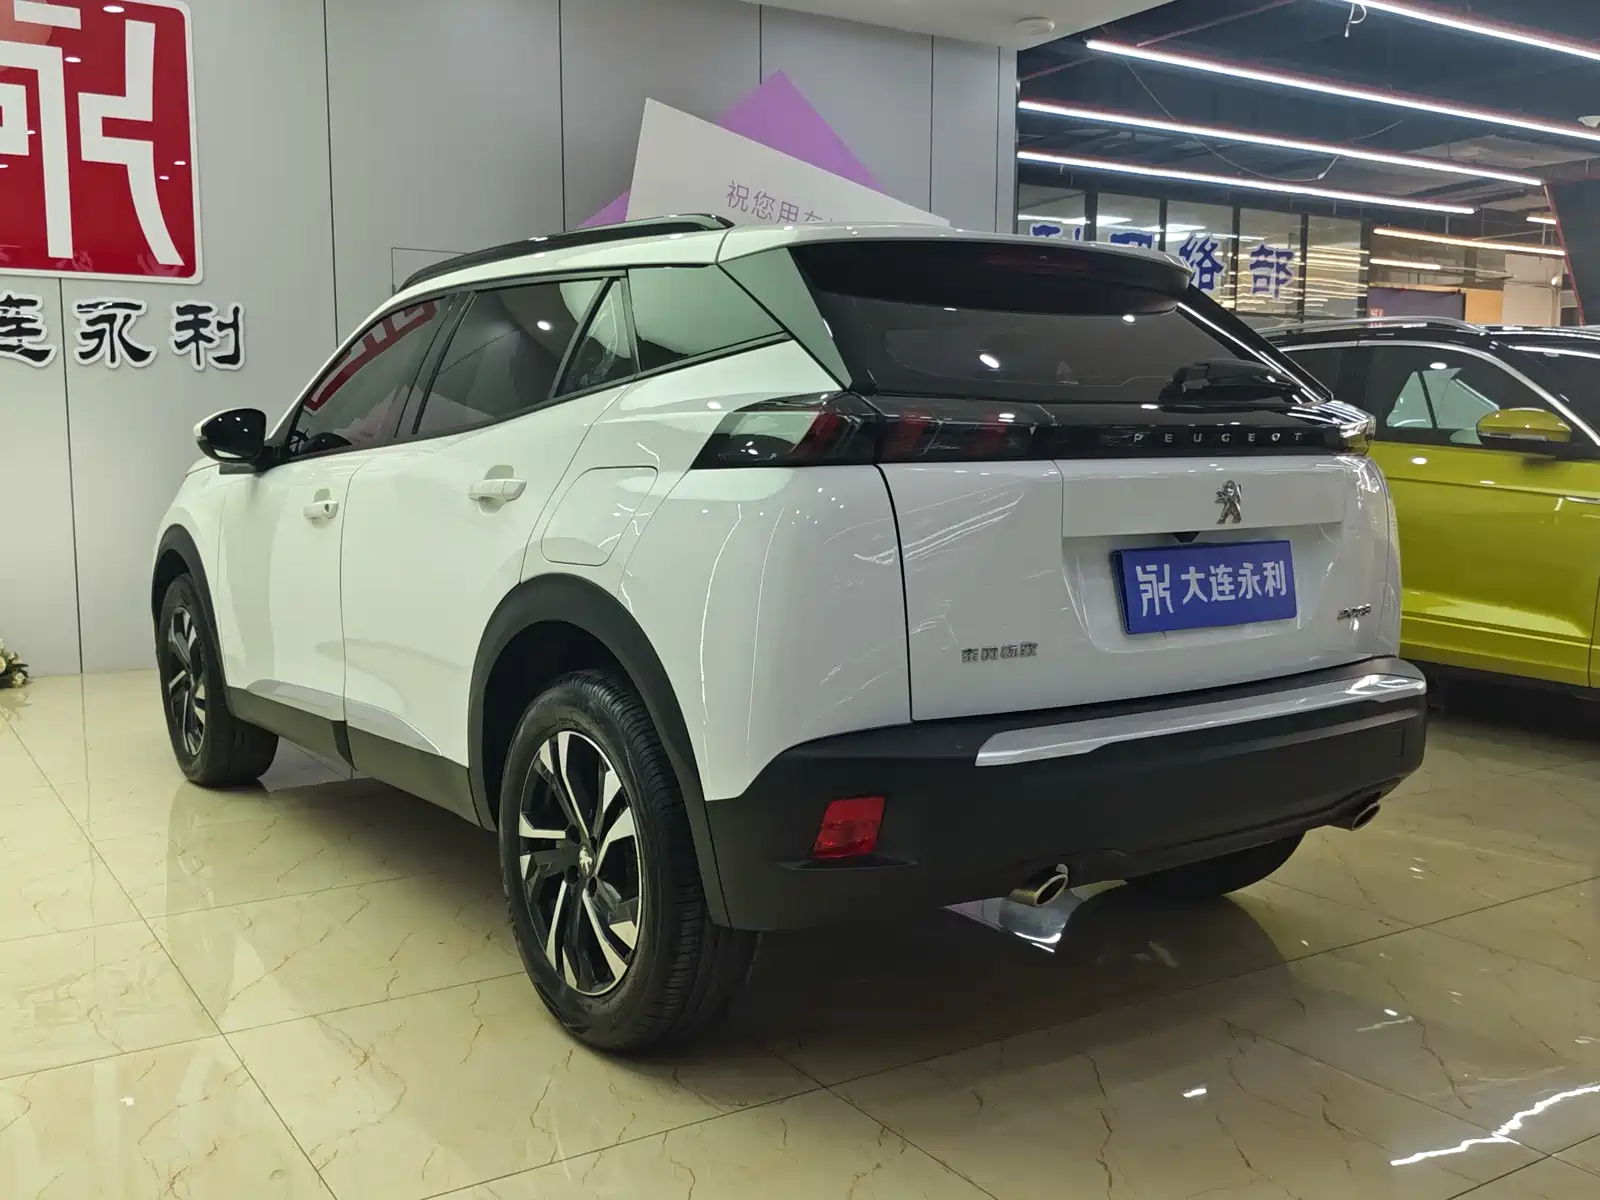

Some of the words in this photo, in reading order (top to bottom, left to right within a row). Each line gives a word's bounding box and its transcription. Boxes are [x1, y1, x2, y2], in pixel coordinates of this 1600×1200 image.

[1133, 432, 1302, 443] PEUGEOT
[1180, 560, 1287, 605] 大连永利
